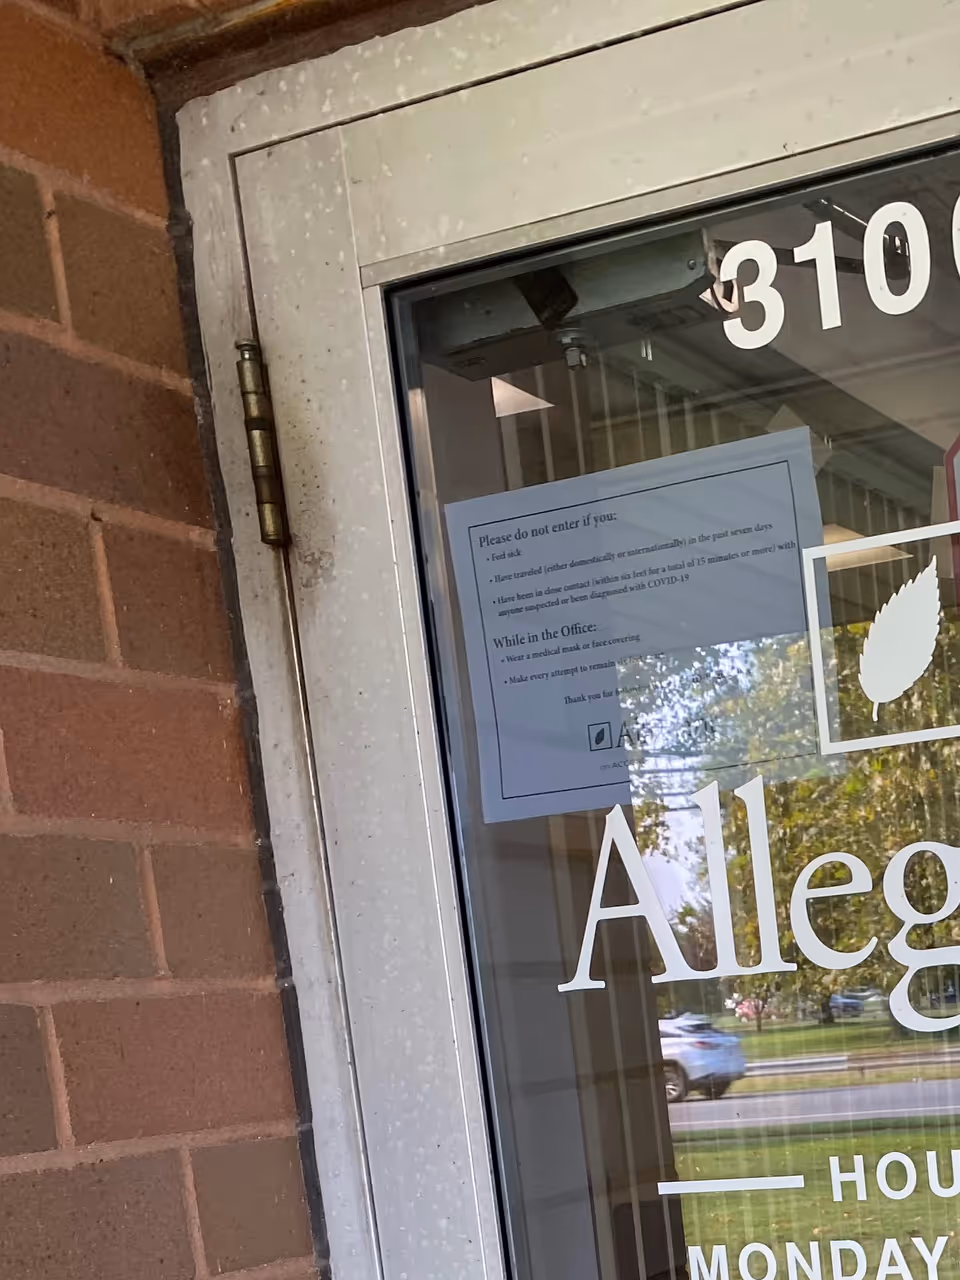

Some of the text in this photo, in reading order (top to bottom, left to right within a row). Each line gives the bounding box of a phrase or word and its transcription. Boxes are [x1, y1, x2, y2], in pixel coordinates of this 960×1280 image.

[479, 512, 617, 548] Please do not enter if you:
[491, 549, 521, 562] Feel sick
[494, 573, 512, 583] Have
[513, 566, 542, 579] traveled
[544, 562, 568, 575] (either
[569, 552, 615, 568] domestically
[617, 551, 626, 559] or
[688, 537, 697, 545] in
[698, 533, 711, 543] the
[712, 530, 729, 542] past
[730, 527, 753, 536] seven
[754, 522, 773, 534] days
[497, 594, 515, 605] Have
[517, 590, 534, 601] been
[535, 588, 543, 597] in
[544, 586, 563, 596] close
[564, 581, 590, 592] contact
[592, 574, 620, 588] (within
[621, 573, 631, 582] six
[632, 568, 647, 579] feet
[648, 566, 660, 576] for
[667, 560, 686, 571] total
[687, 557, 696, 568] of
[697, 557, 706, 567] 15
[707, 551, 740, 564] minutes
[777, 540, 796, 550] with
[498, 606, 524, 618] anyone
[525, 597, 560, 612] suspected
[570, 592, 589, 603] been
[589, 585, 628, 600] diagnosed
[629, 582, 646, 592] with
[647, 574, 690, 589] COVID-19
[493, 622, 597, 649] While in the Office:
[506, 652, 524, 663] Wear
[532, 647, 561, 660] medical
[562, 643, 581, 654] mask
[583, 643, 591, 651] or
[592, 638, 607, 648] face
[608, 633, 641, 647] covering
[509, 675, 529, 685] Make
[530, 672, 550, 683] every
[551, 667, 579, 681] attempt
[580, 664, 588, 673] to
[589, 661, 616, 671] remain
[564, 694, 586, 705] Thank
[588, 692, 601, 704] you
[602, 690, 613, 699] for
